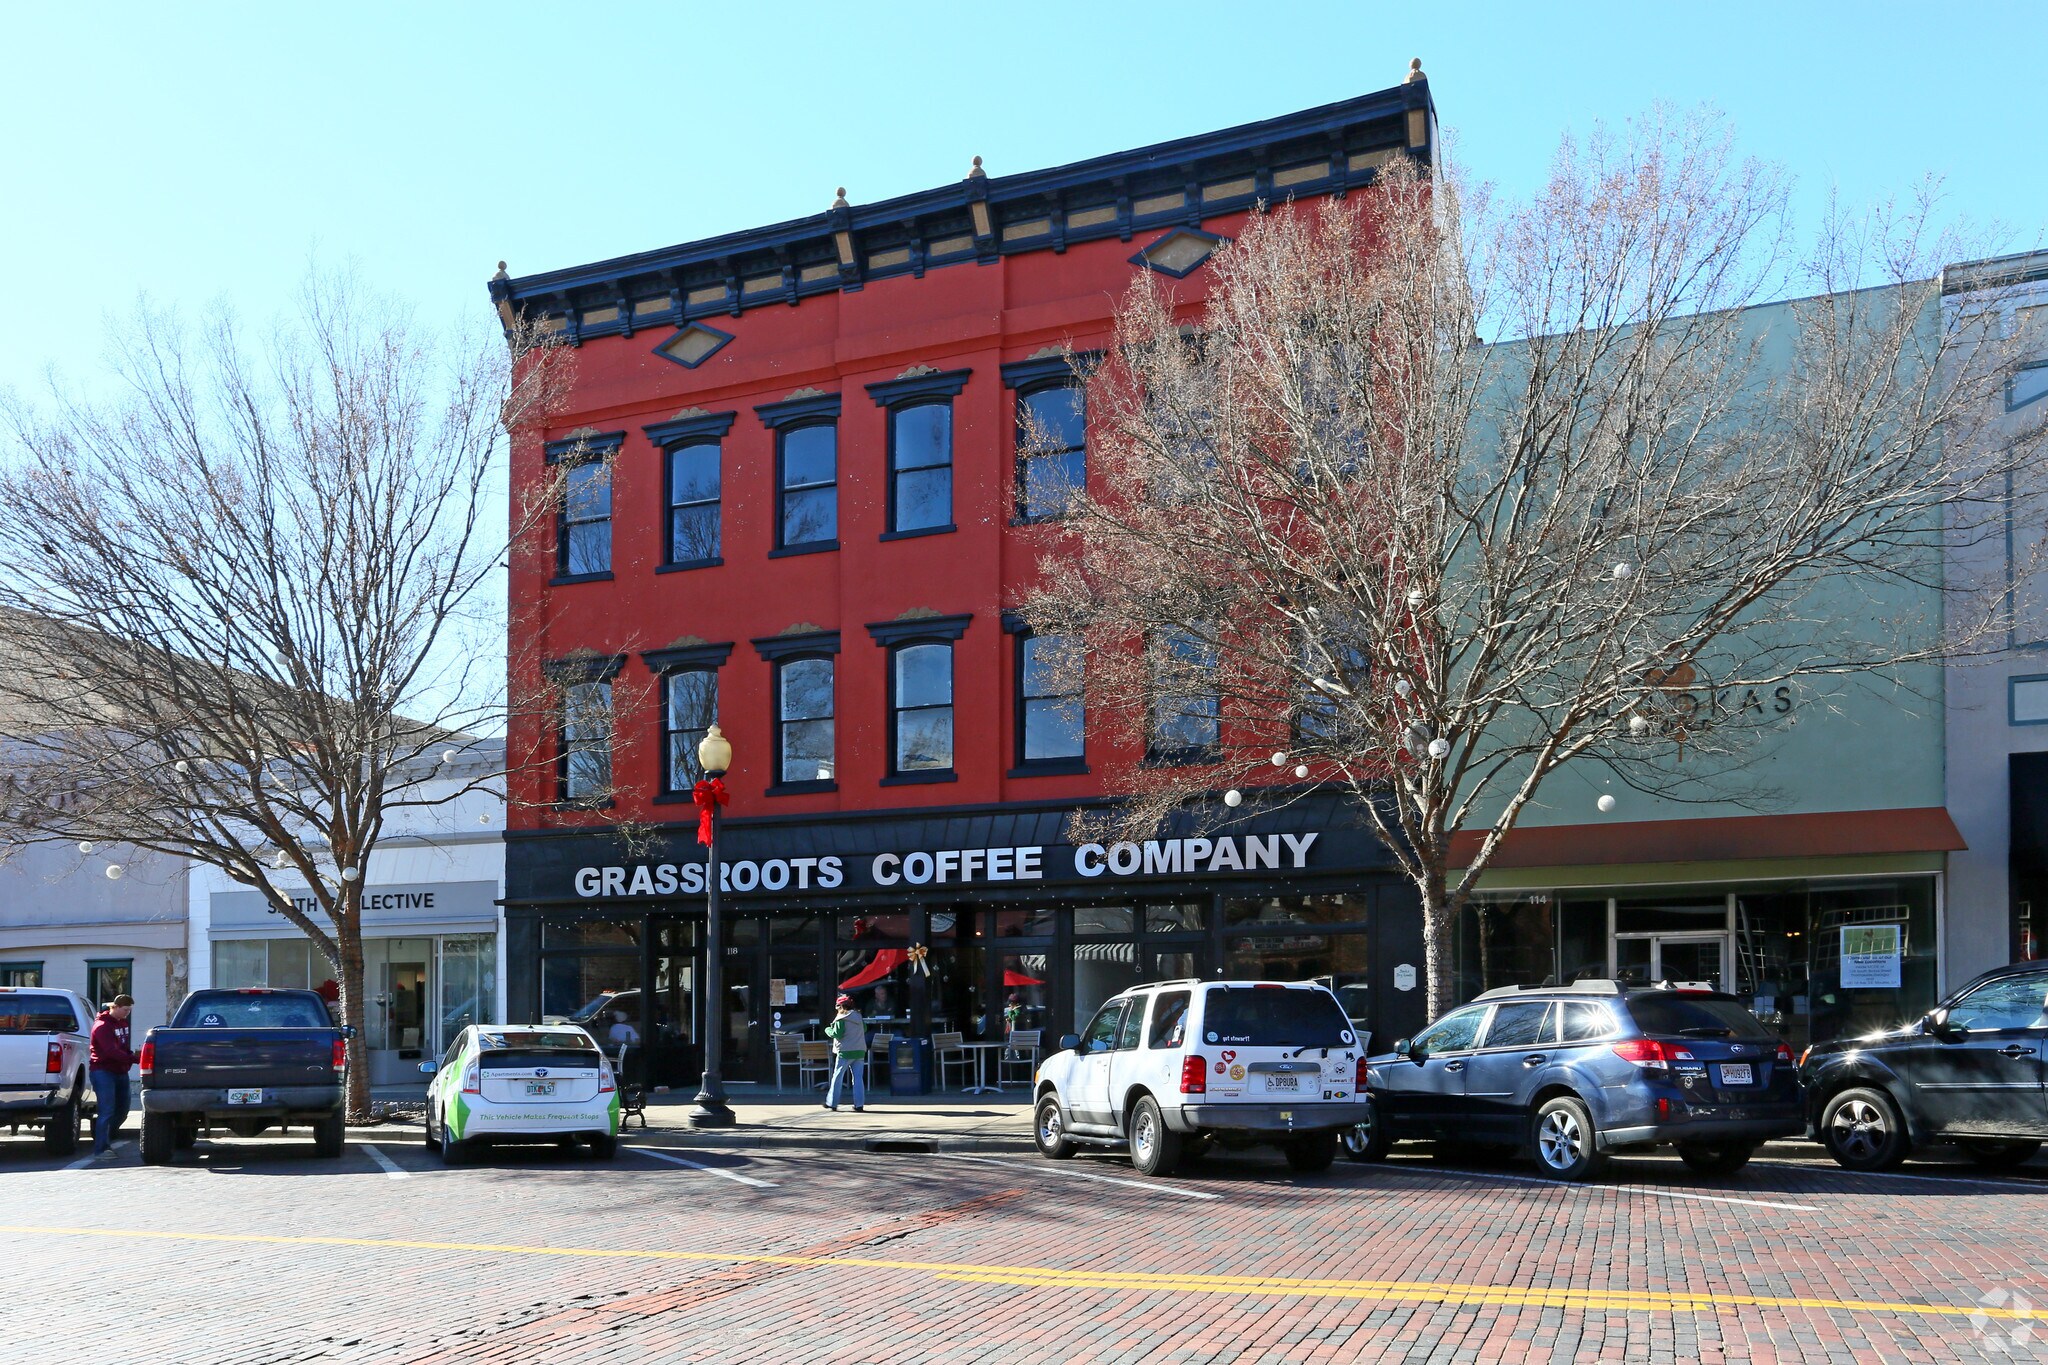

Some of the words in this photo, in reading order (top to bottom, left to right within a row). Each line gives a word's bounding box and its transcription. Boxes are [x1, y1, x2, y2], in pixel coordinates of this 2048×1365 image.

[575, 856, 843, 897] GRASSROOTS
[872, 846, 1043, 886] COFFEE
[1074, 832, 1319, 877] COMPANY
[267, 898, 318, 914] STH
[328, 893, 434, 911] LECTIVE
[1529, 895, 1547, 905] 114
[727, 947, 739, 955] 118
[547, 1113, 578, 1121] Frequent
[580, 1113, 599, 1121] Stops
